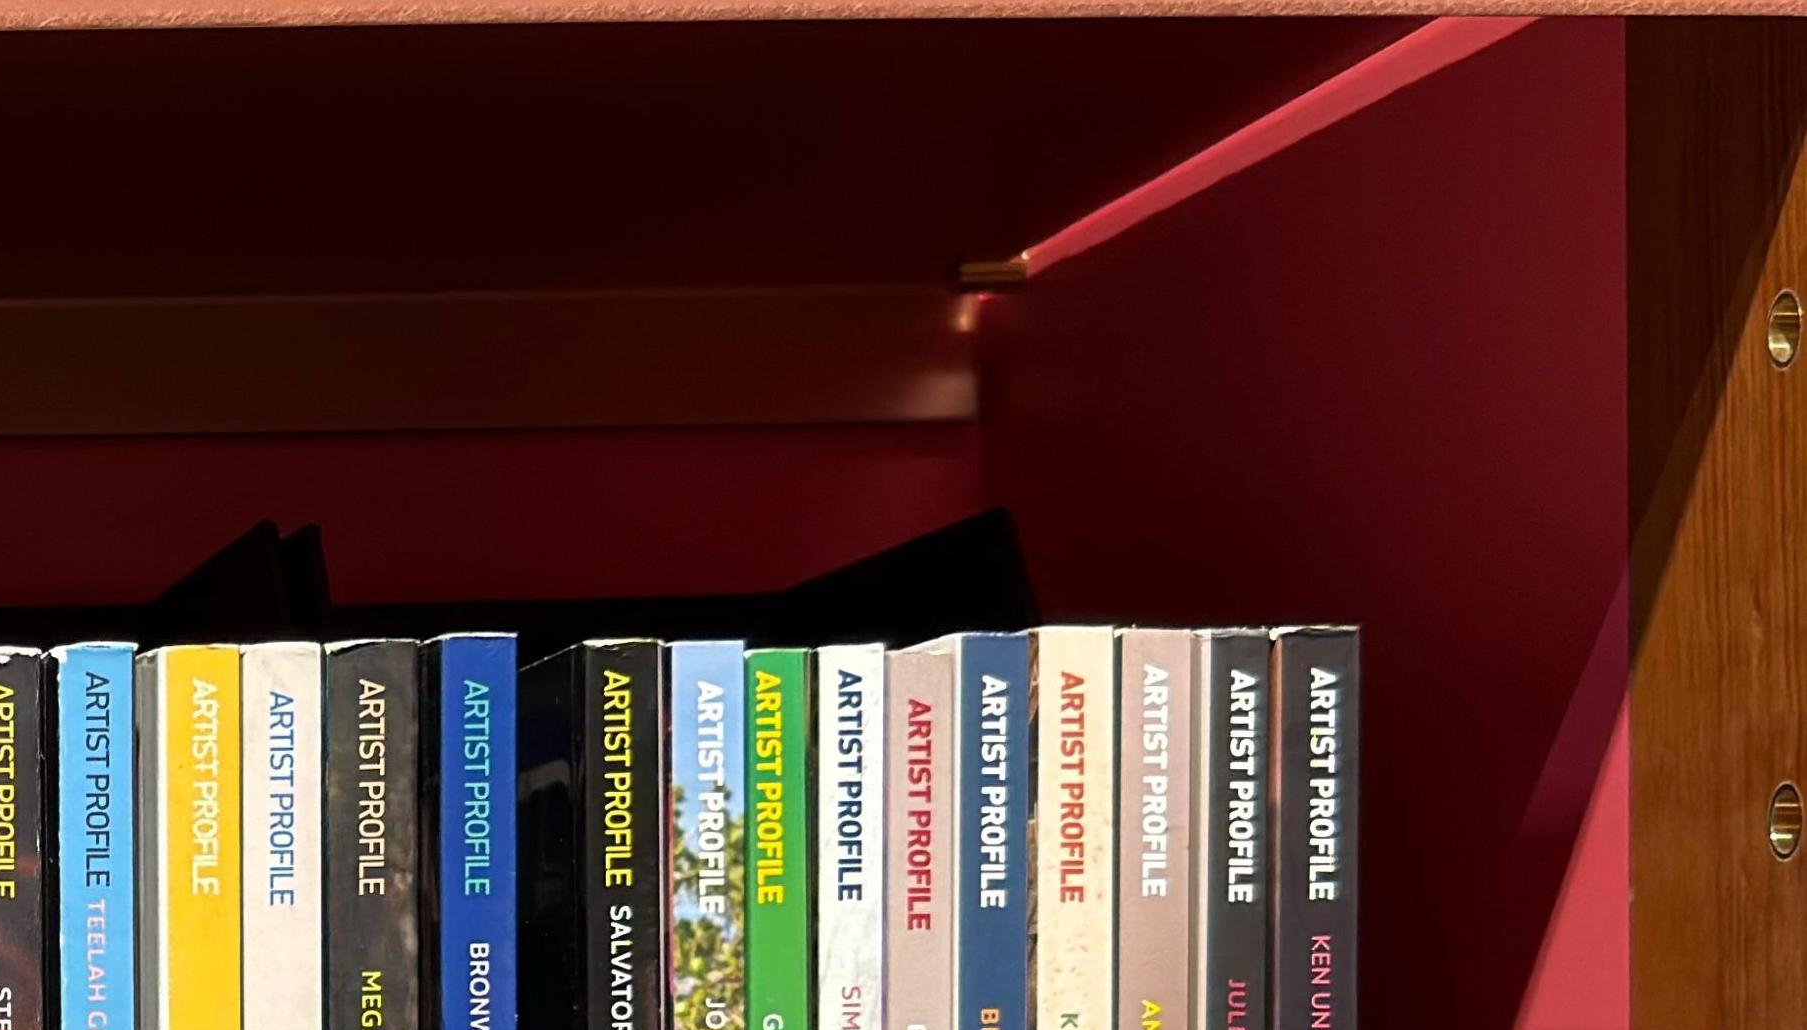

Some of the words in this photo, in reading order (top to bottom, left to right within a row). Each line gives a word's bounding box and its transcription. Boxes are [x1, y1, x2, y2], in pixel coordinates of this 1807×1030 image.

[269, 691, 293, 785] ARTIST
[464, 679, 489, 774] ARTIST
[756, 671, 781, 775] ARTIST
[907, 699, 930, 802] ARTIST
[1060, 671, 1083, 775] ARTIST
[1310, 668, 1335, 772] ARTIST
[270, 792, 294, 906] PROFILE
[464, 782, 489, 895] PROFILE
[757, 782, 781, 903] PROFILE
[908, 810, 931, 930] PROFILE
[1060, 783, 1084, 902] PROFILE
[1310, 779, 1335, 900] PROFILE
[1310, 935, 1330, 985] KEN
